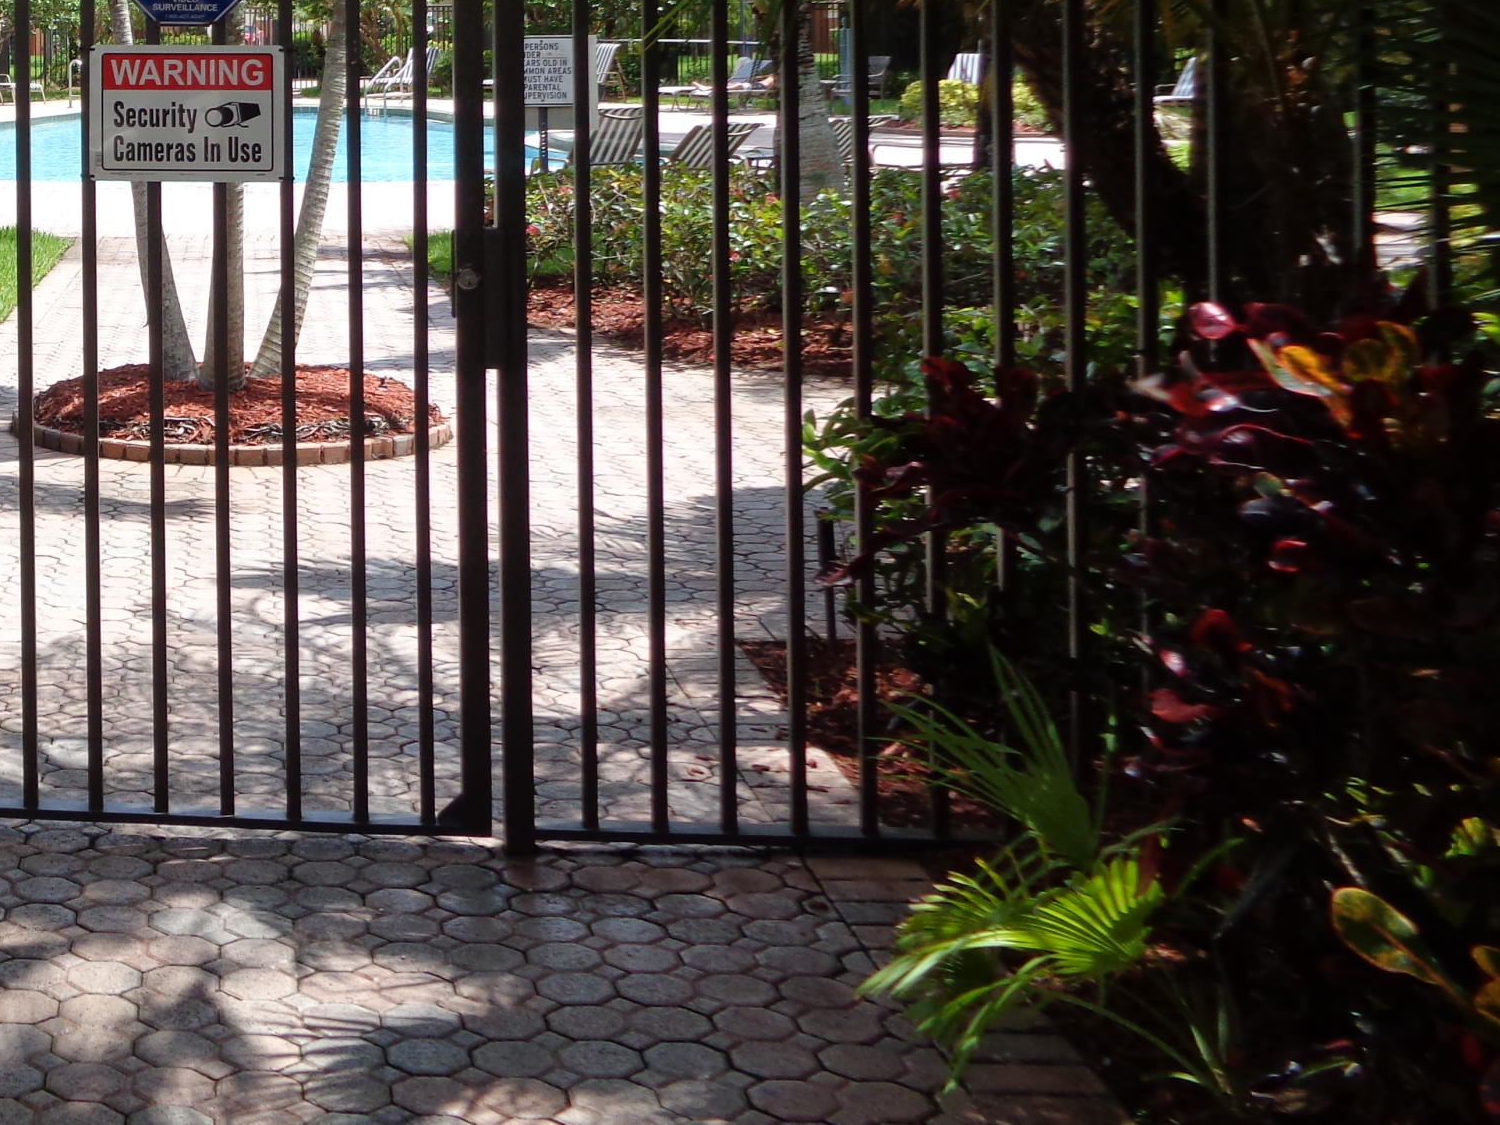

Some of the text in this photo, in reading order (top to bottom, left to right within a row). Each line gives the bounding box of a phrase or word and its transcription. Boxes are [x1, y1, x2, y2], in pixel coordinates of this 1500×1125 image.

[152, 3, 218, 12] SURVEILLANCE
[524, 43, 559, 51] PERSONS
[524, 51, 541, 59] DER
[542, 59, 558, 67] OLD
[110, 59, 265, 86] WARNING
[547, 66, 572, 75] AREAS
[543, 75, 564, 83] HAVE
[113, 100, 197, 133] Security
[113, 135, 196, 163] Cameras
[203, 135, 221, 163] In
[228, 136, 262, 163] Use
